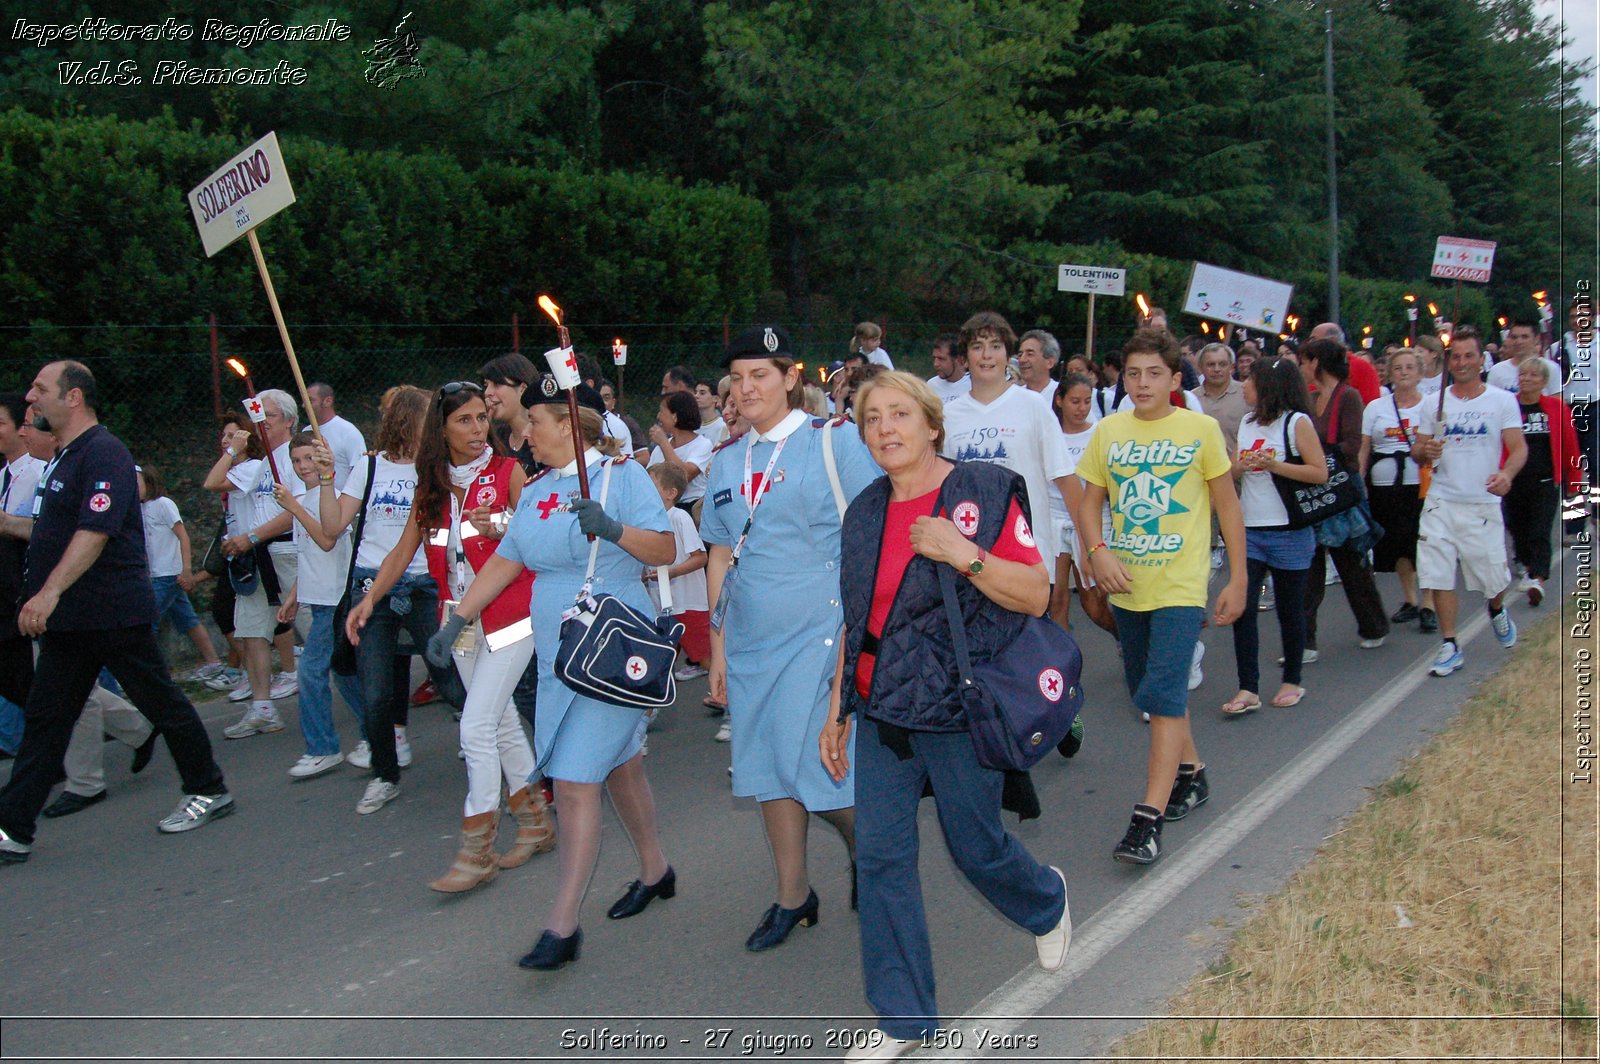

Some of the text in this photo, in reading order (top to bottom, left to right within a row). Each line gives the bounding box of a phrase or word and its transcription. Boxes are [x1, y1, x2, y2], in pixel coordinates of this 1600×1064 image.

[196, 149, 271, 224] SOLFERINO
[236, 213, 250, 228] ITALY
[1064, 268, 1120, 280] TOLENTINO
[1434, 265, 1486, 280] NOVARA
[971, 427, 999, 446] 150
[1107, 440, 1195, 467] Maths
[389, 479, 416, 494] 150
[1300, 492, 1337, 514] BAG
[1108, 528, 1184, 557] League
